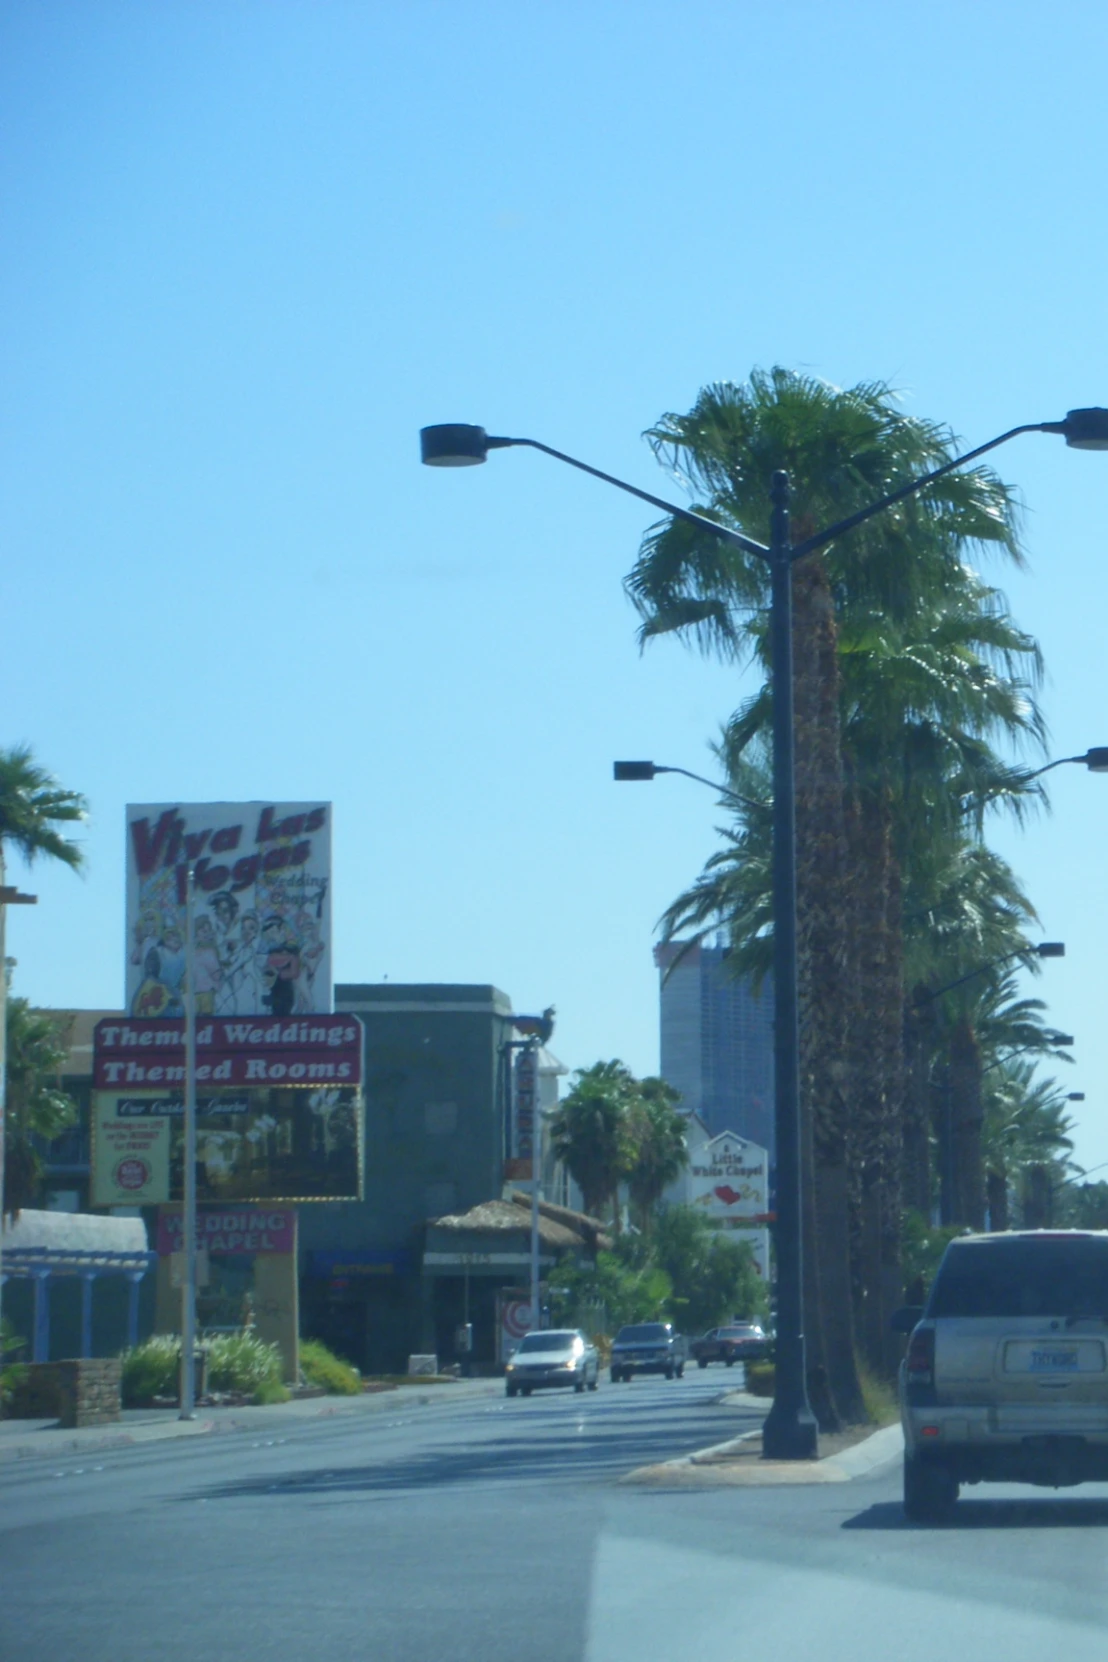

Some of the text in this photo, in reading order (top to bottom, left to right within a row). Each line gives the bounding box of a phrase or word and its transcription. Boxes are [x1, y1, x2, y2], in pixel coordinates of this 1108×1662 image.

[130, 806, 326, 876] Viva Las
[175, 839, 311, 905] Vegas
[223, 1022, 356, 1046] Weddings
[103, 1058, 351, 1083] Themed Rooms
[712, 1153, 743, 1165] Little
